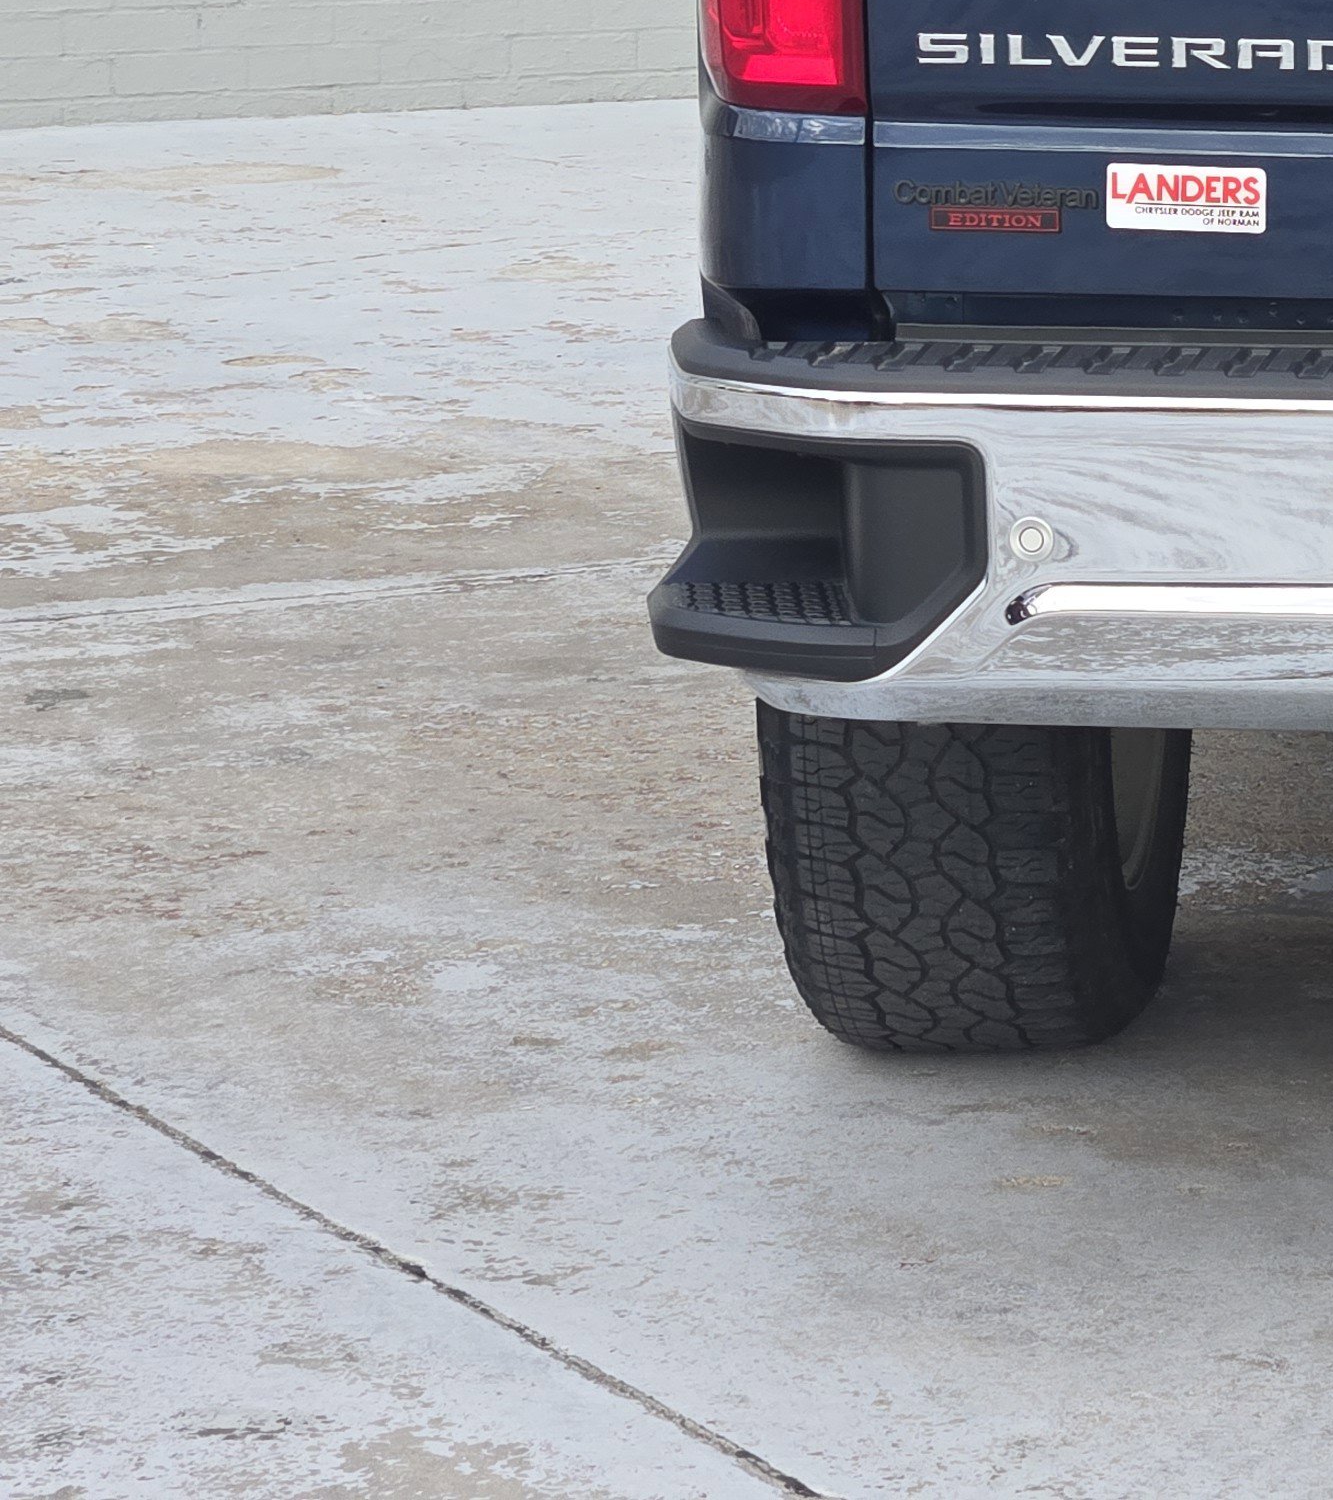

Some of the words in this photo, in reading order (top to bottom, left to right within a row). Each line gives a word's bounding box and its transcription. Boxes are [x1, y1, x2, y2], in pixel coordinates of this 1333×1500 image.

[895, 180, 995, 206] Combat
[1002, 182, 1098, 209] Veteran
[1111, 172, 1261, 205] LANDERS
[1134, 206, 1179, 215] CHRYSLER
[1181, 207, 1214, 217] DODGE
[1217, 209, 1237, 218] JEEP
[1239, 210, 1260, 218] RAM
[948, 214, 1042, 228] EDITION
[1202, 217, 1214, 226] OF
[1217, 217, 1260, 227] NORMAN
